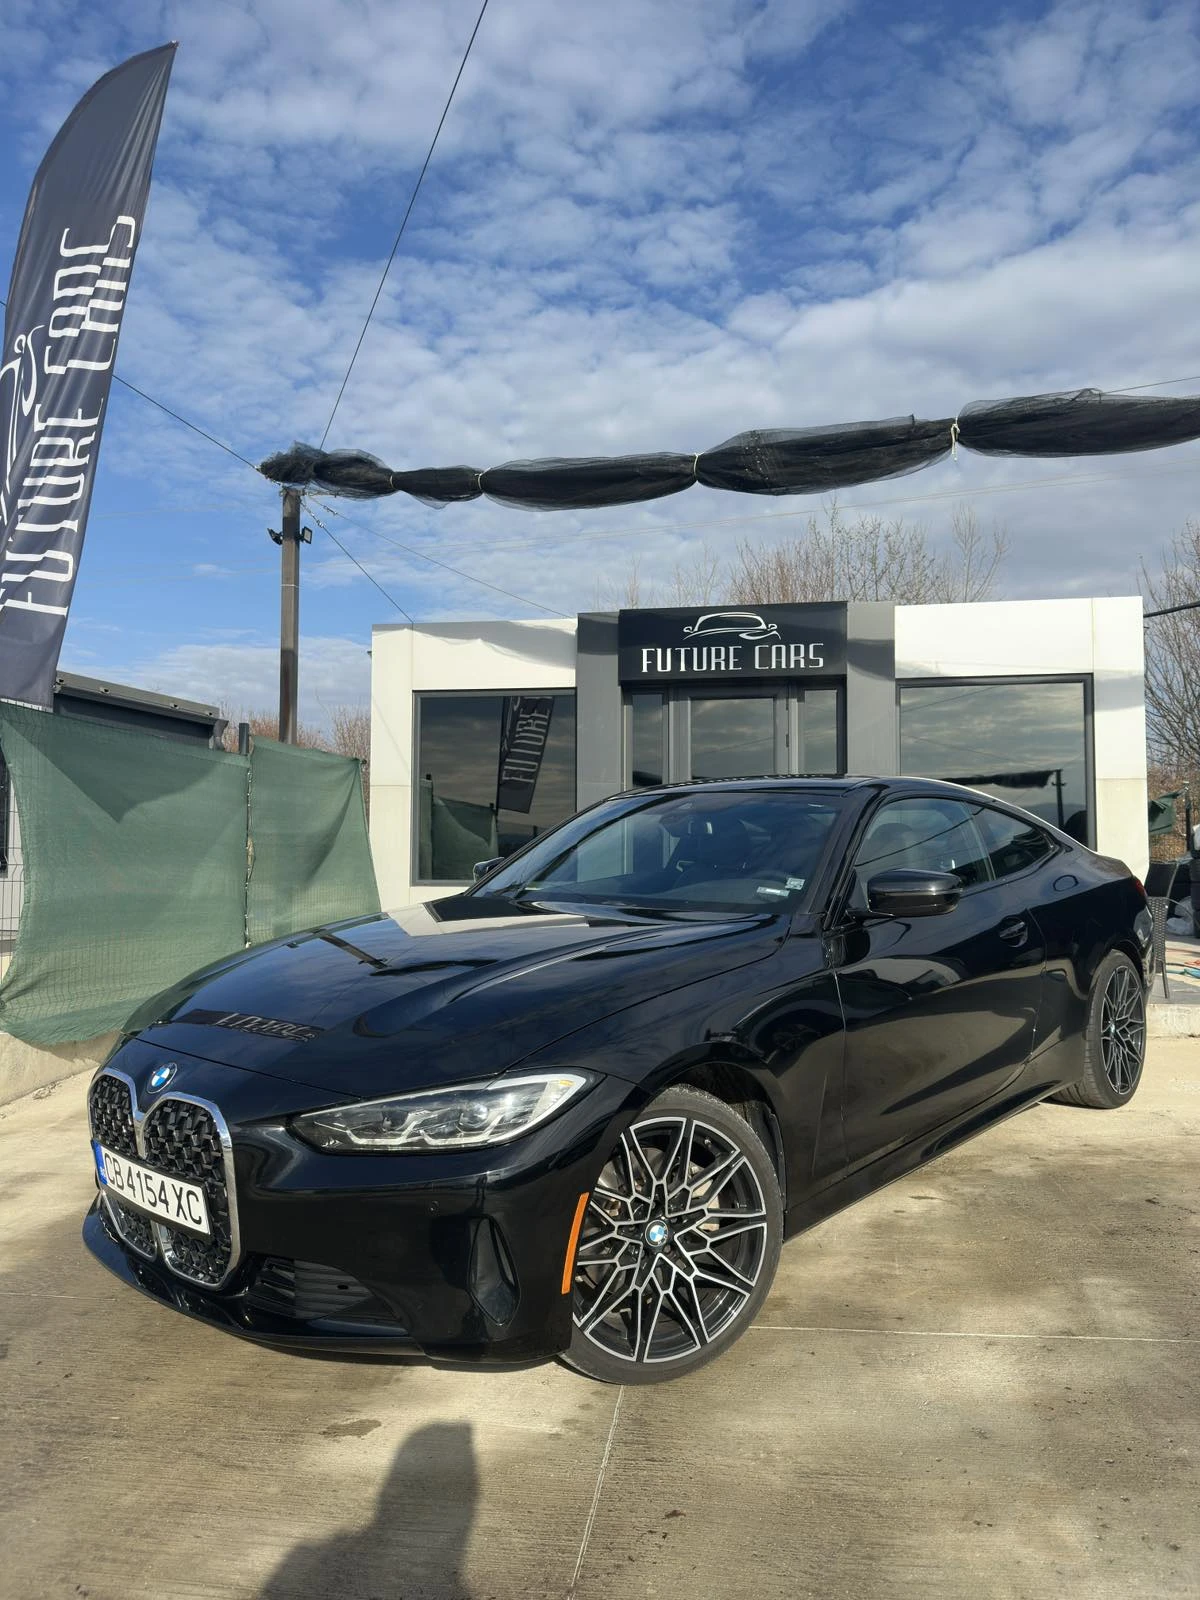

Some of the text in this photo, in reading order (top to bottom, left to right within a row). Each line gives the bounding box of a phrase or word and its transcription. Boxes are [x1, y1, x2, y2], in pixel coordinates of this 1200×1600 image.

[0, 215, 136, 619] FUTURE CARS
[641, 643, 824, 673] FUTURE CARS
